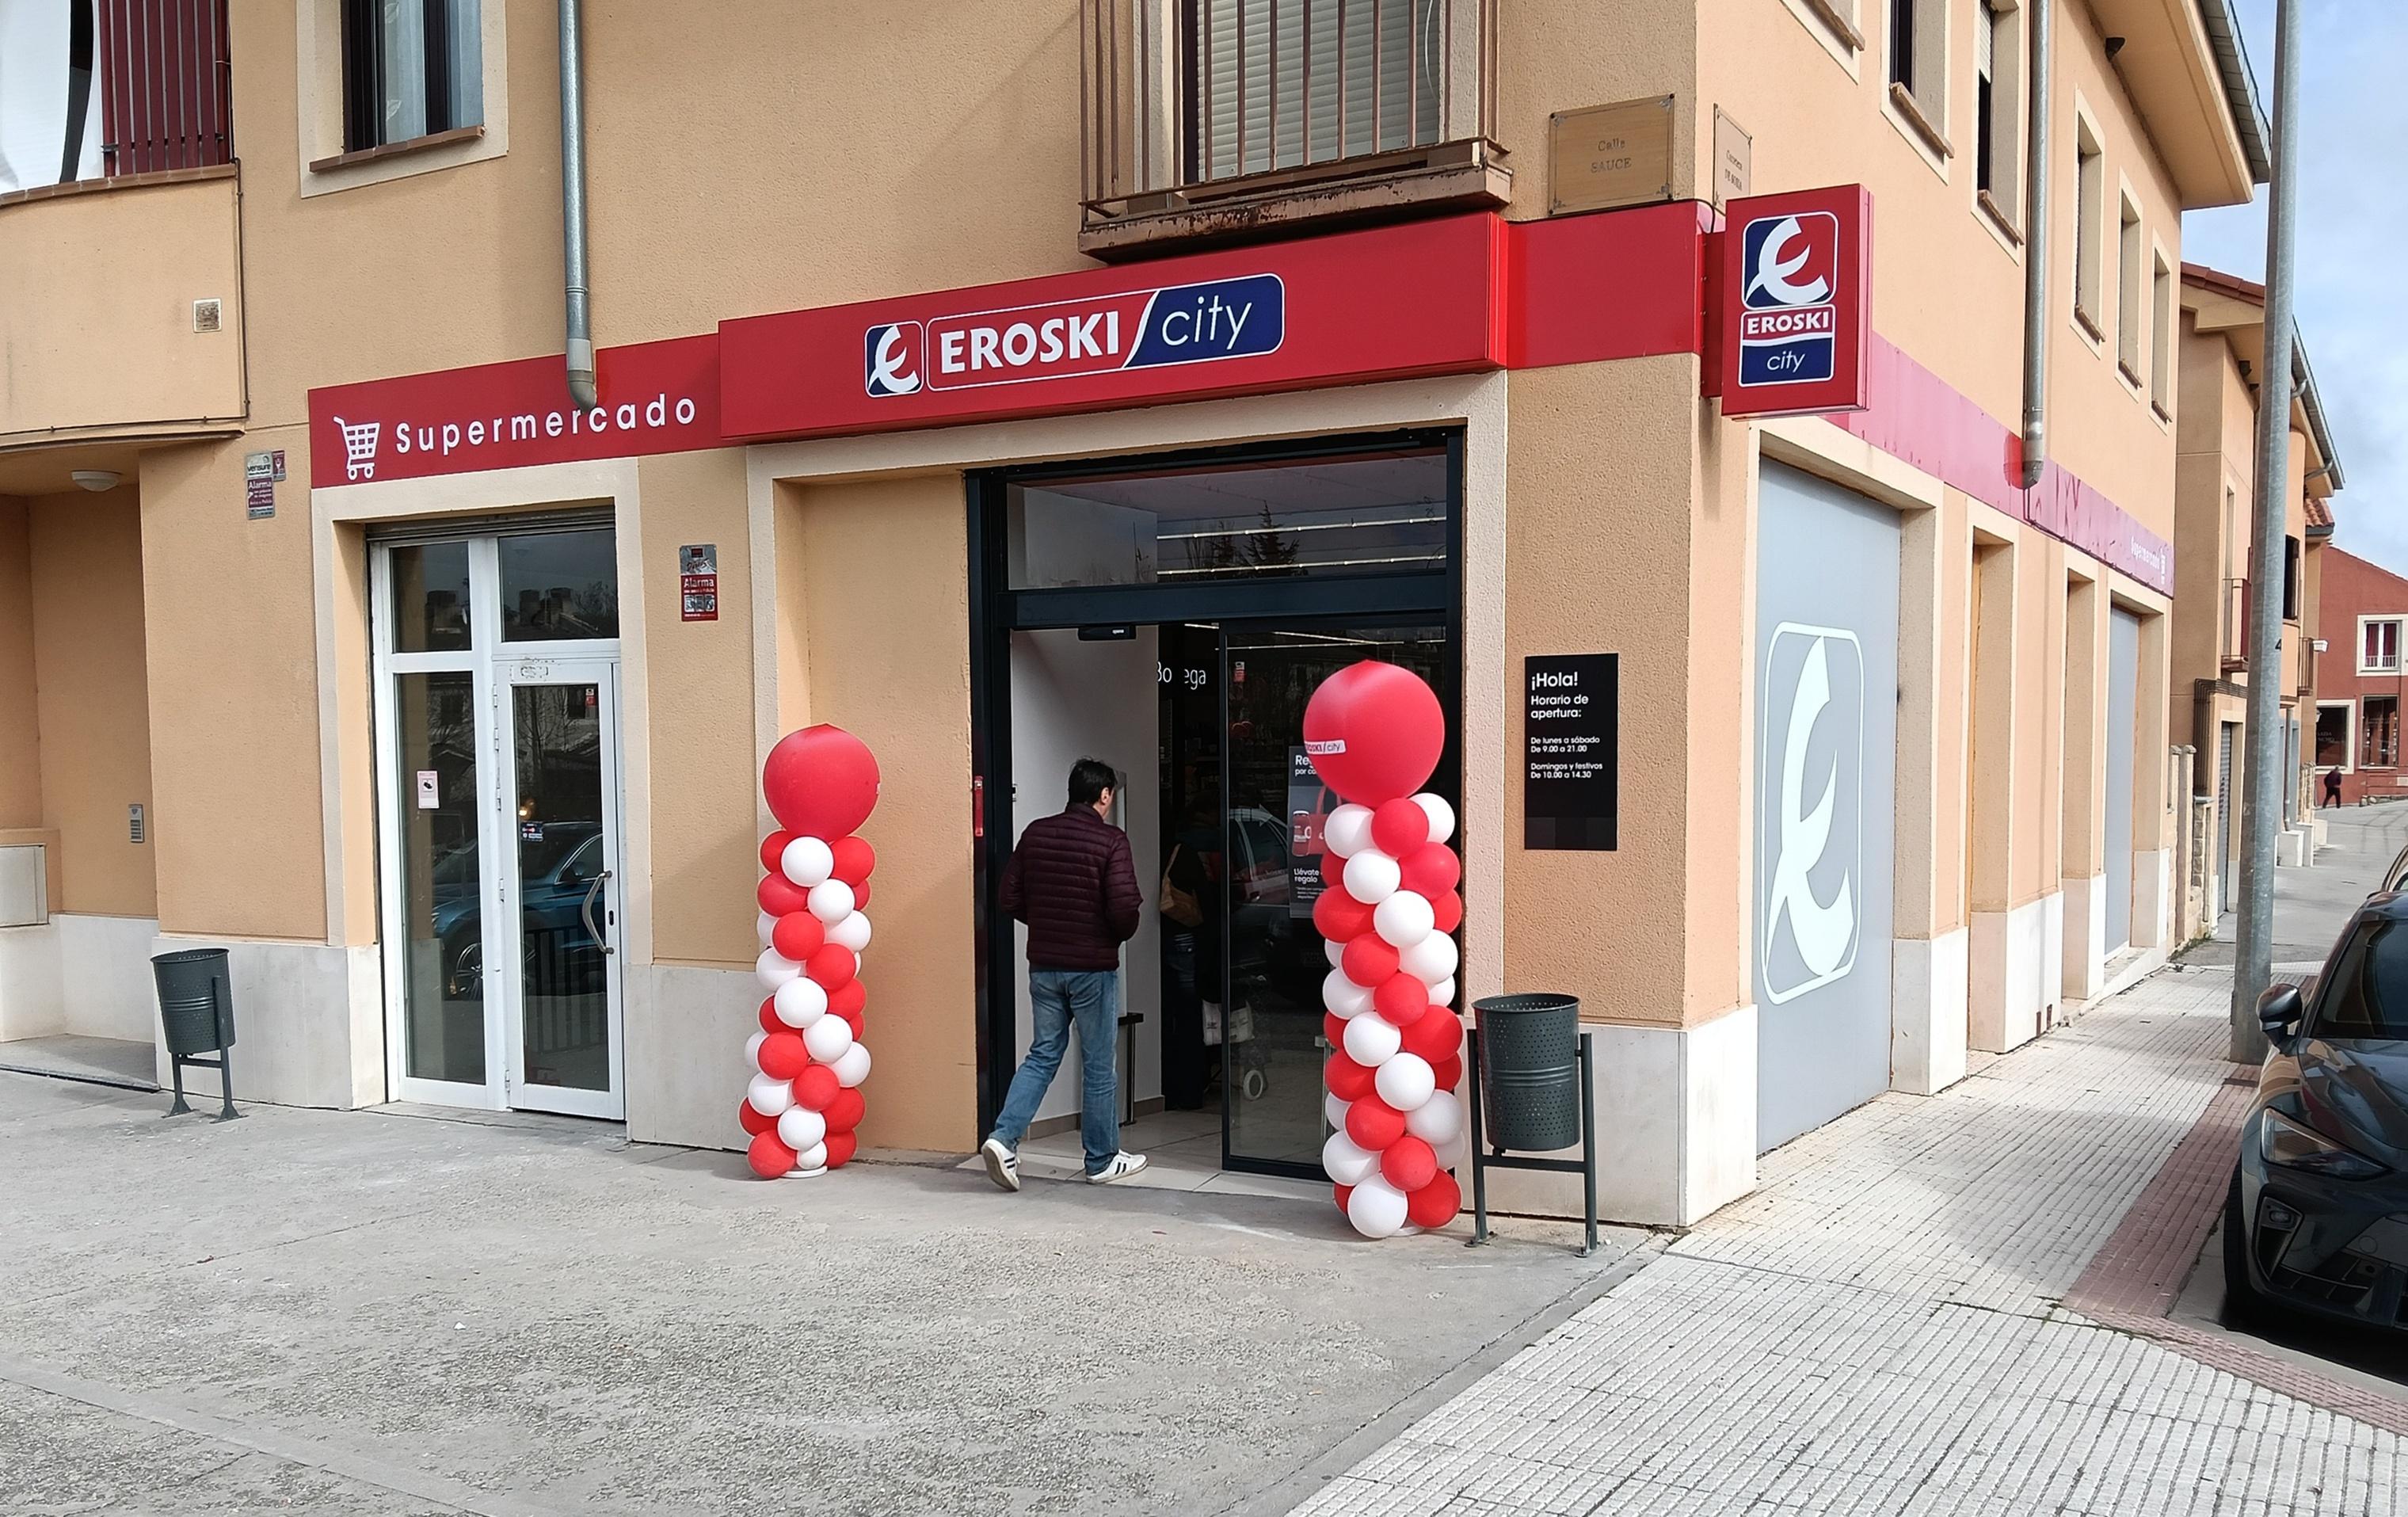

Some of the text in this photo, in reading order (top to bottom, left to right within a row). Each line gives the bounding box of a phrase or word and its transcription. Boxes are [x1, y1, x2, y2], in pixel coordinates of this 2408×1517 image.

[1598, 138, 1625, 151] Calle
[1591, 158, 1632, 173] SAUCE
[1747, 311, 1829, 335] EROSKI
[940, 295, 1252, 374] EROSKI city
[1766, 351, 1805, 372] city
[395, 393, 695, 455] Supermercado
[684, 577, 714, 588] Alarma
[1531, 671, 1578, 691] ¡Hola!
[1530, 694, 1589, 705] Horario de
[1530, 707, 1582, 720] apertura:
[1571, 735, 1600, 744] sábado
[1294, 768, 1306, 777] por
[1530, 762, 1568, 772] Domingos
[1294, 867, 1320, 876] Llévate
[1294, 875, 1318, 884] regalo
